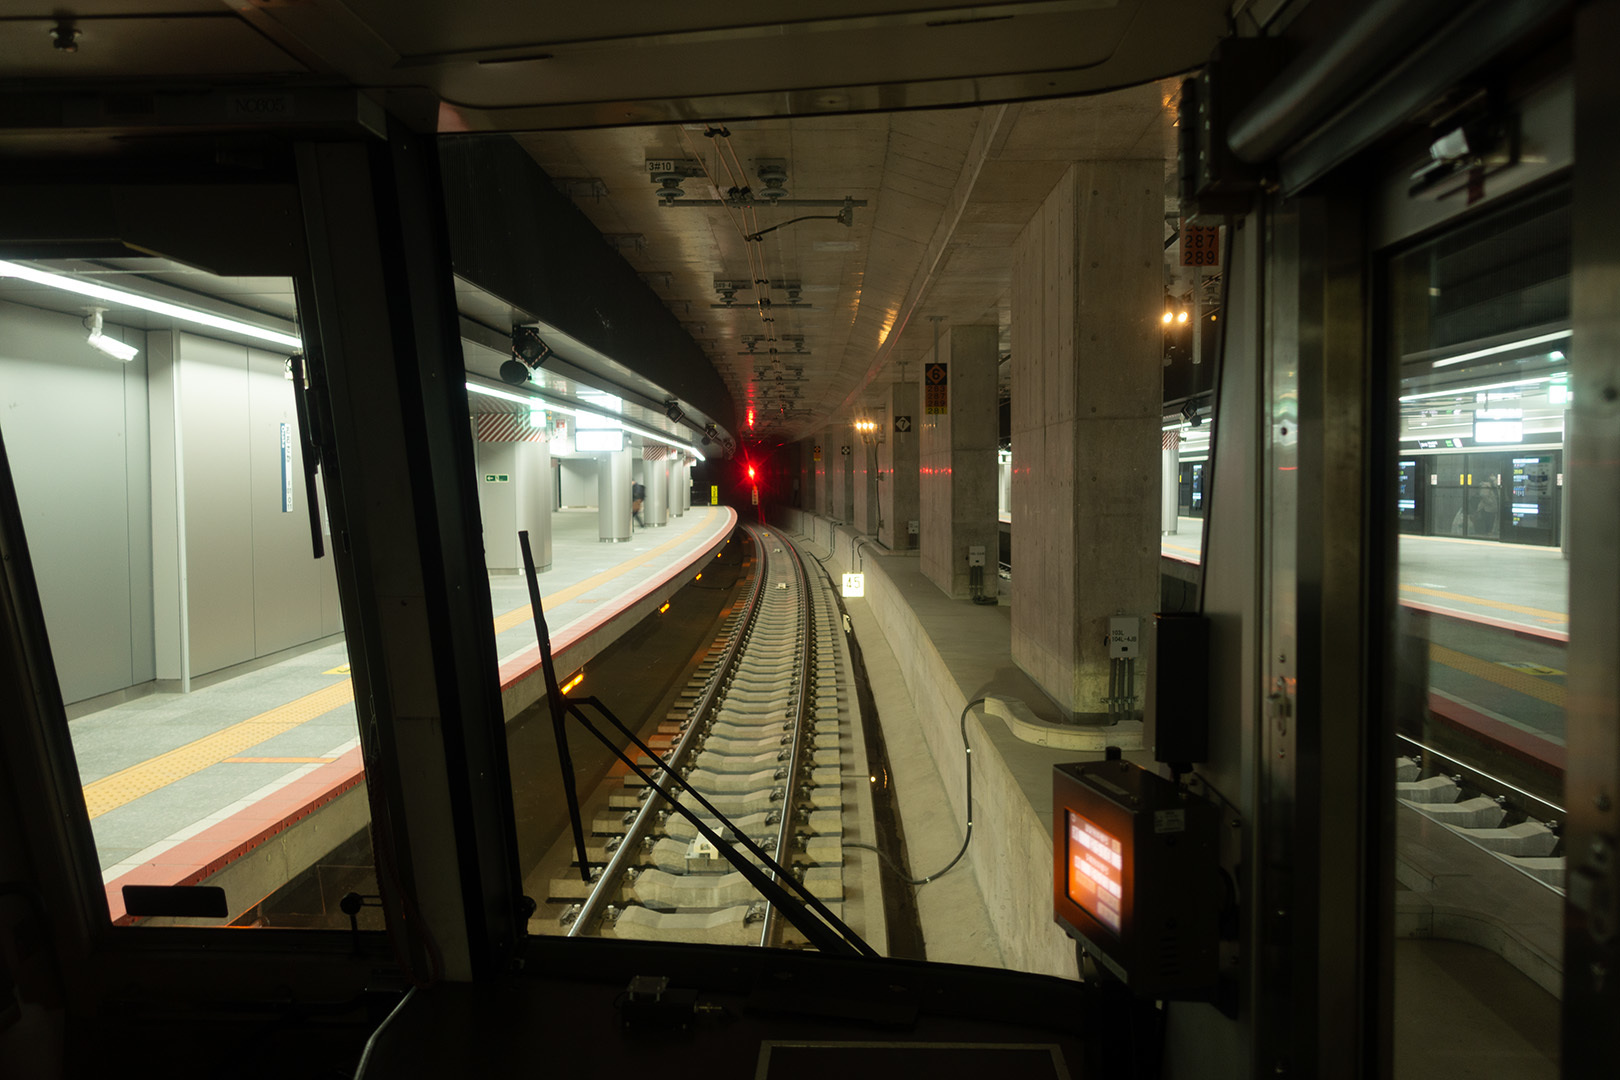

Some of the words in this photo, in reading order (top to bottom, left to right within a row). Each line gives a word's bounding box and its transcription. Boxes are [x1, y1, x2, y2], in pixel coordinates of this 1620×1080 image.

[648, 162, 672, 171] 3#10
[1184, 234, 1215, 249] 287
[1184, 250, 1215, 265] 289
[932, 368, 941, 380] 6
[927, 407, 945, 415] 281
[846, 576, 861, 589] 45
